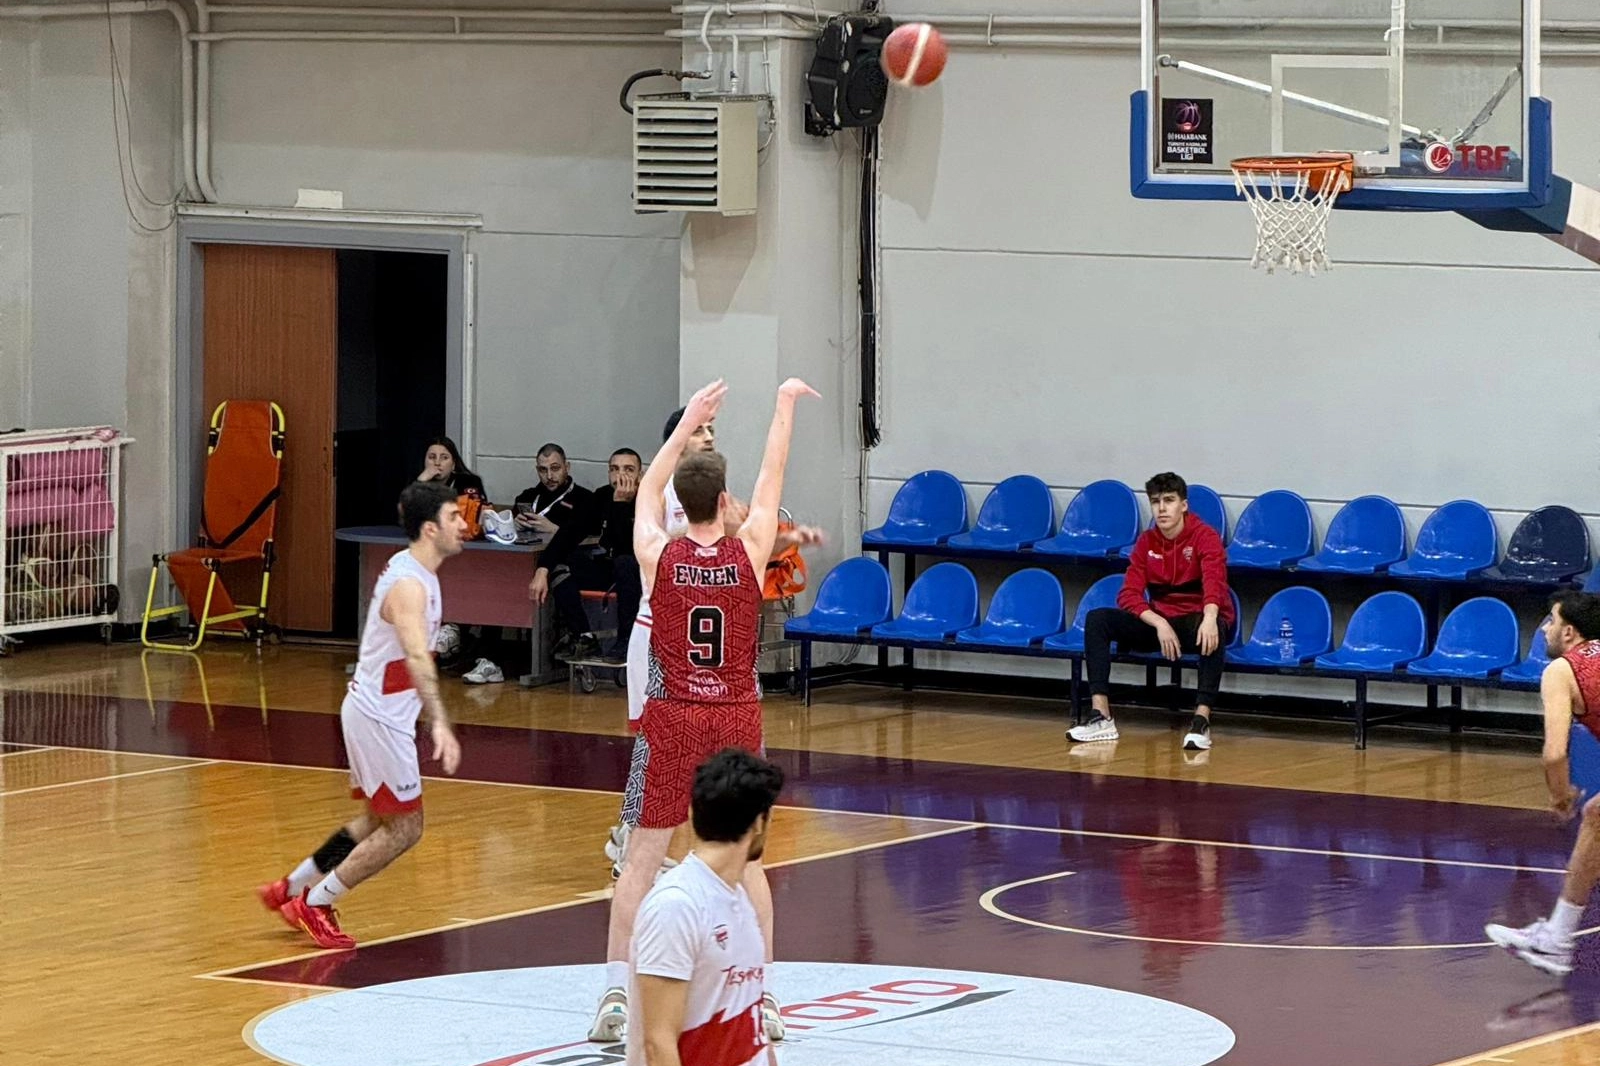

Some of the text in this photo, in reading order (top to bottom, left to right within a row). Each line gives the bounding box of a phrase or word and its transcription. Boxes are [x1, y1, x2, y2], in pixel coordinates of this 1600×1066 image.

[1456, 145, 1510, 171] TBF
[673, 563, 740, 587] EVREN
[688, 605, 725, 668] 9
